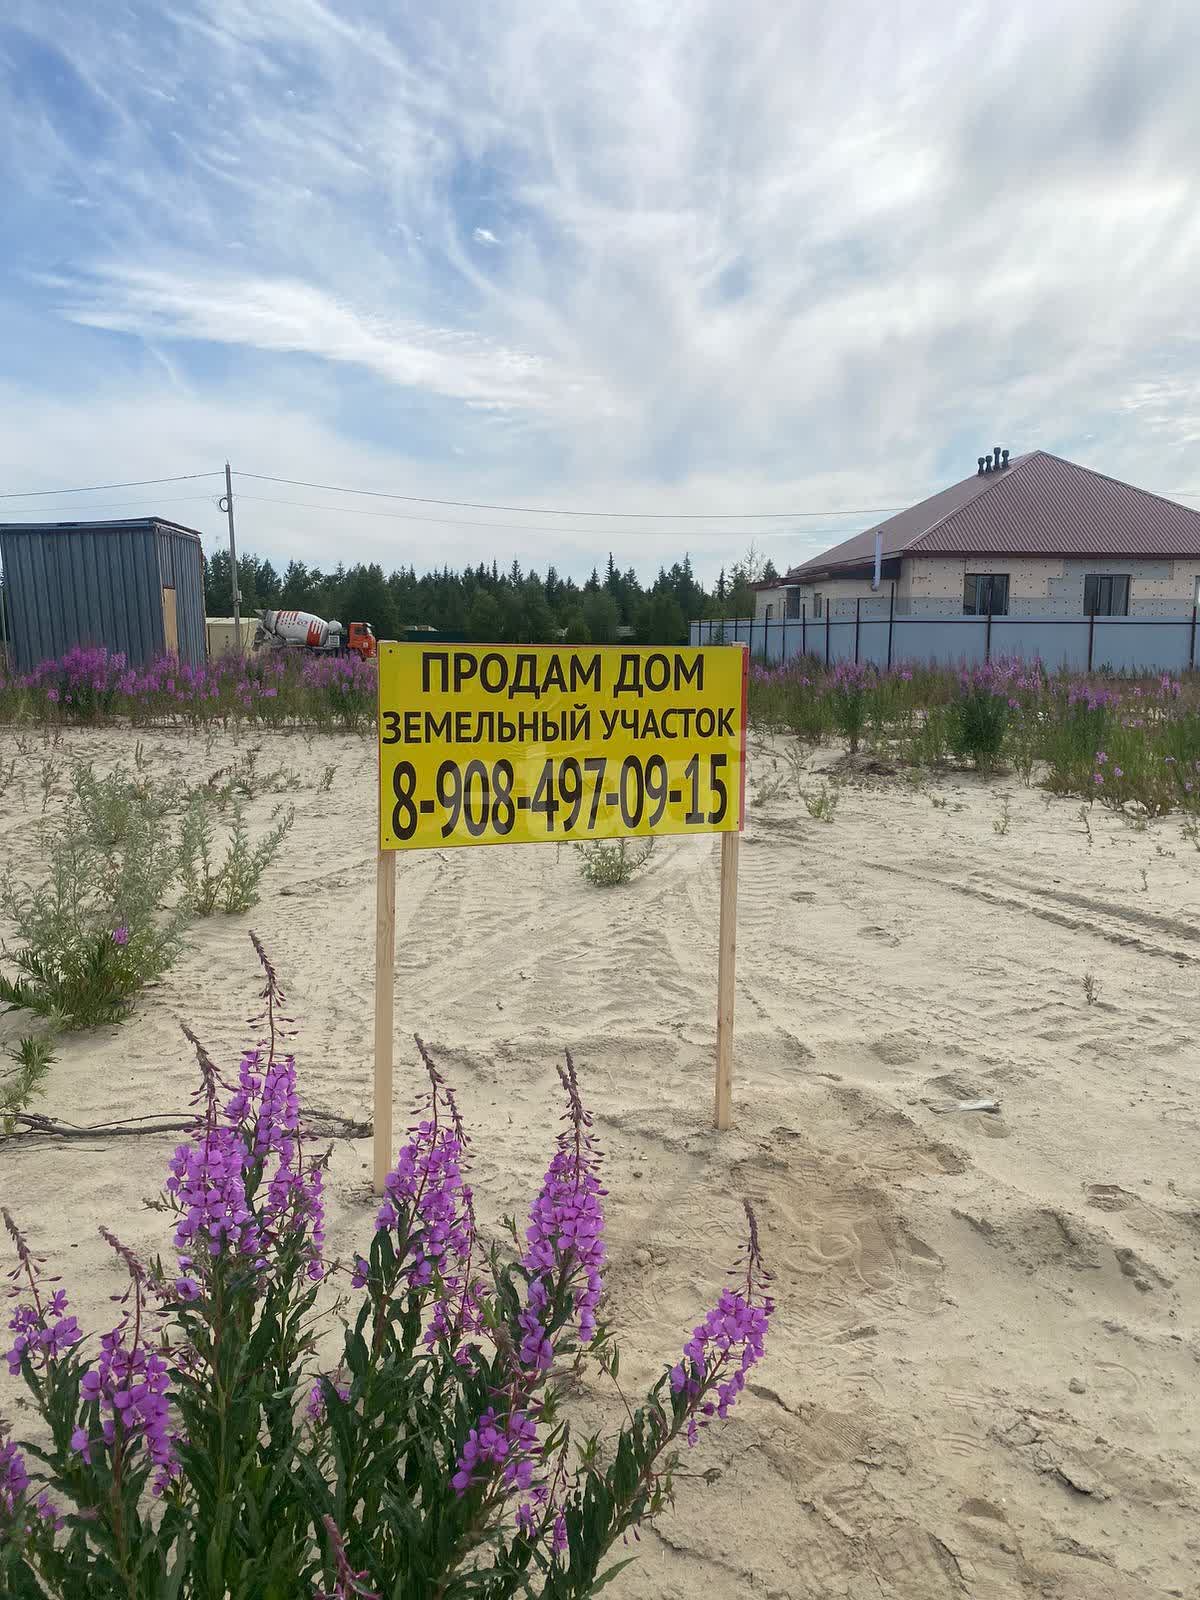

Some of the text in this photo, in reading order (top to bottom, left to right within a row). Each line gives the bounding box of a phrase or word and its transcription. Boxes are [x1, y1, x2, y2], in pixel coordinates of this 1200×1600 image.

[422, 652, 704, 699] ПРОДАМ ДОМ
[382, 704, 735, 744] ЗЕМЕЛЬНЫЙ УЧАСТОК
[392, 753, 727, 840] 8-908-497-09-15
